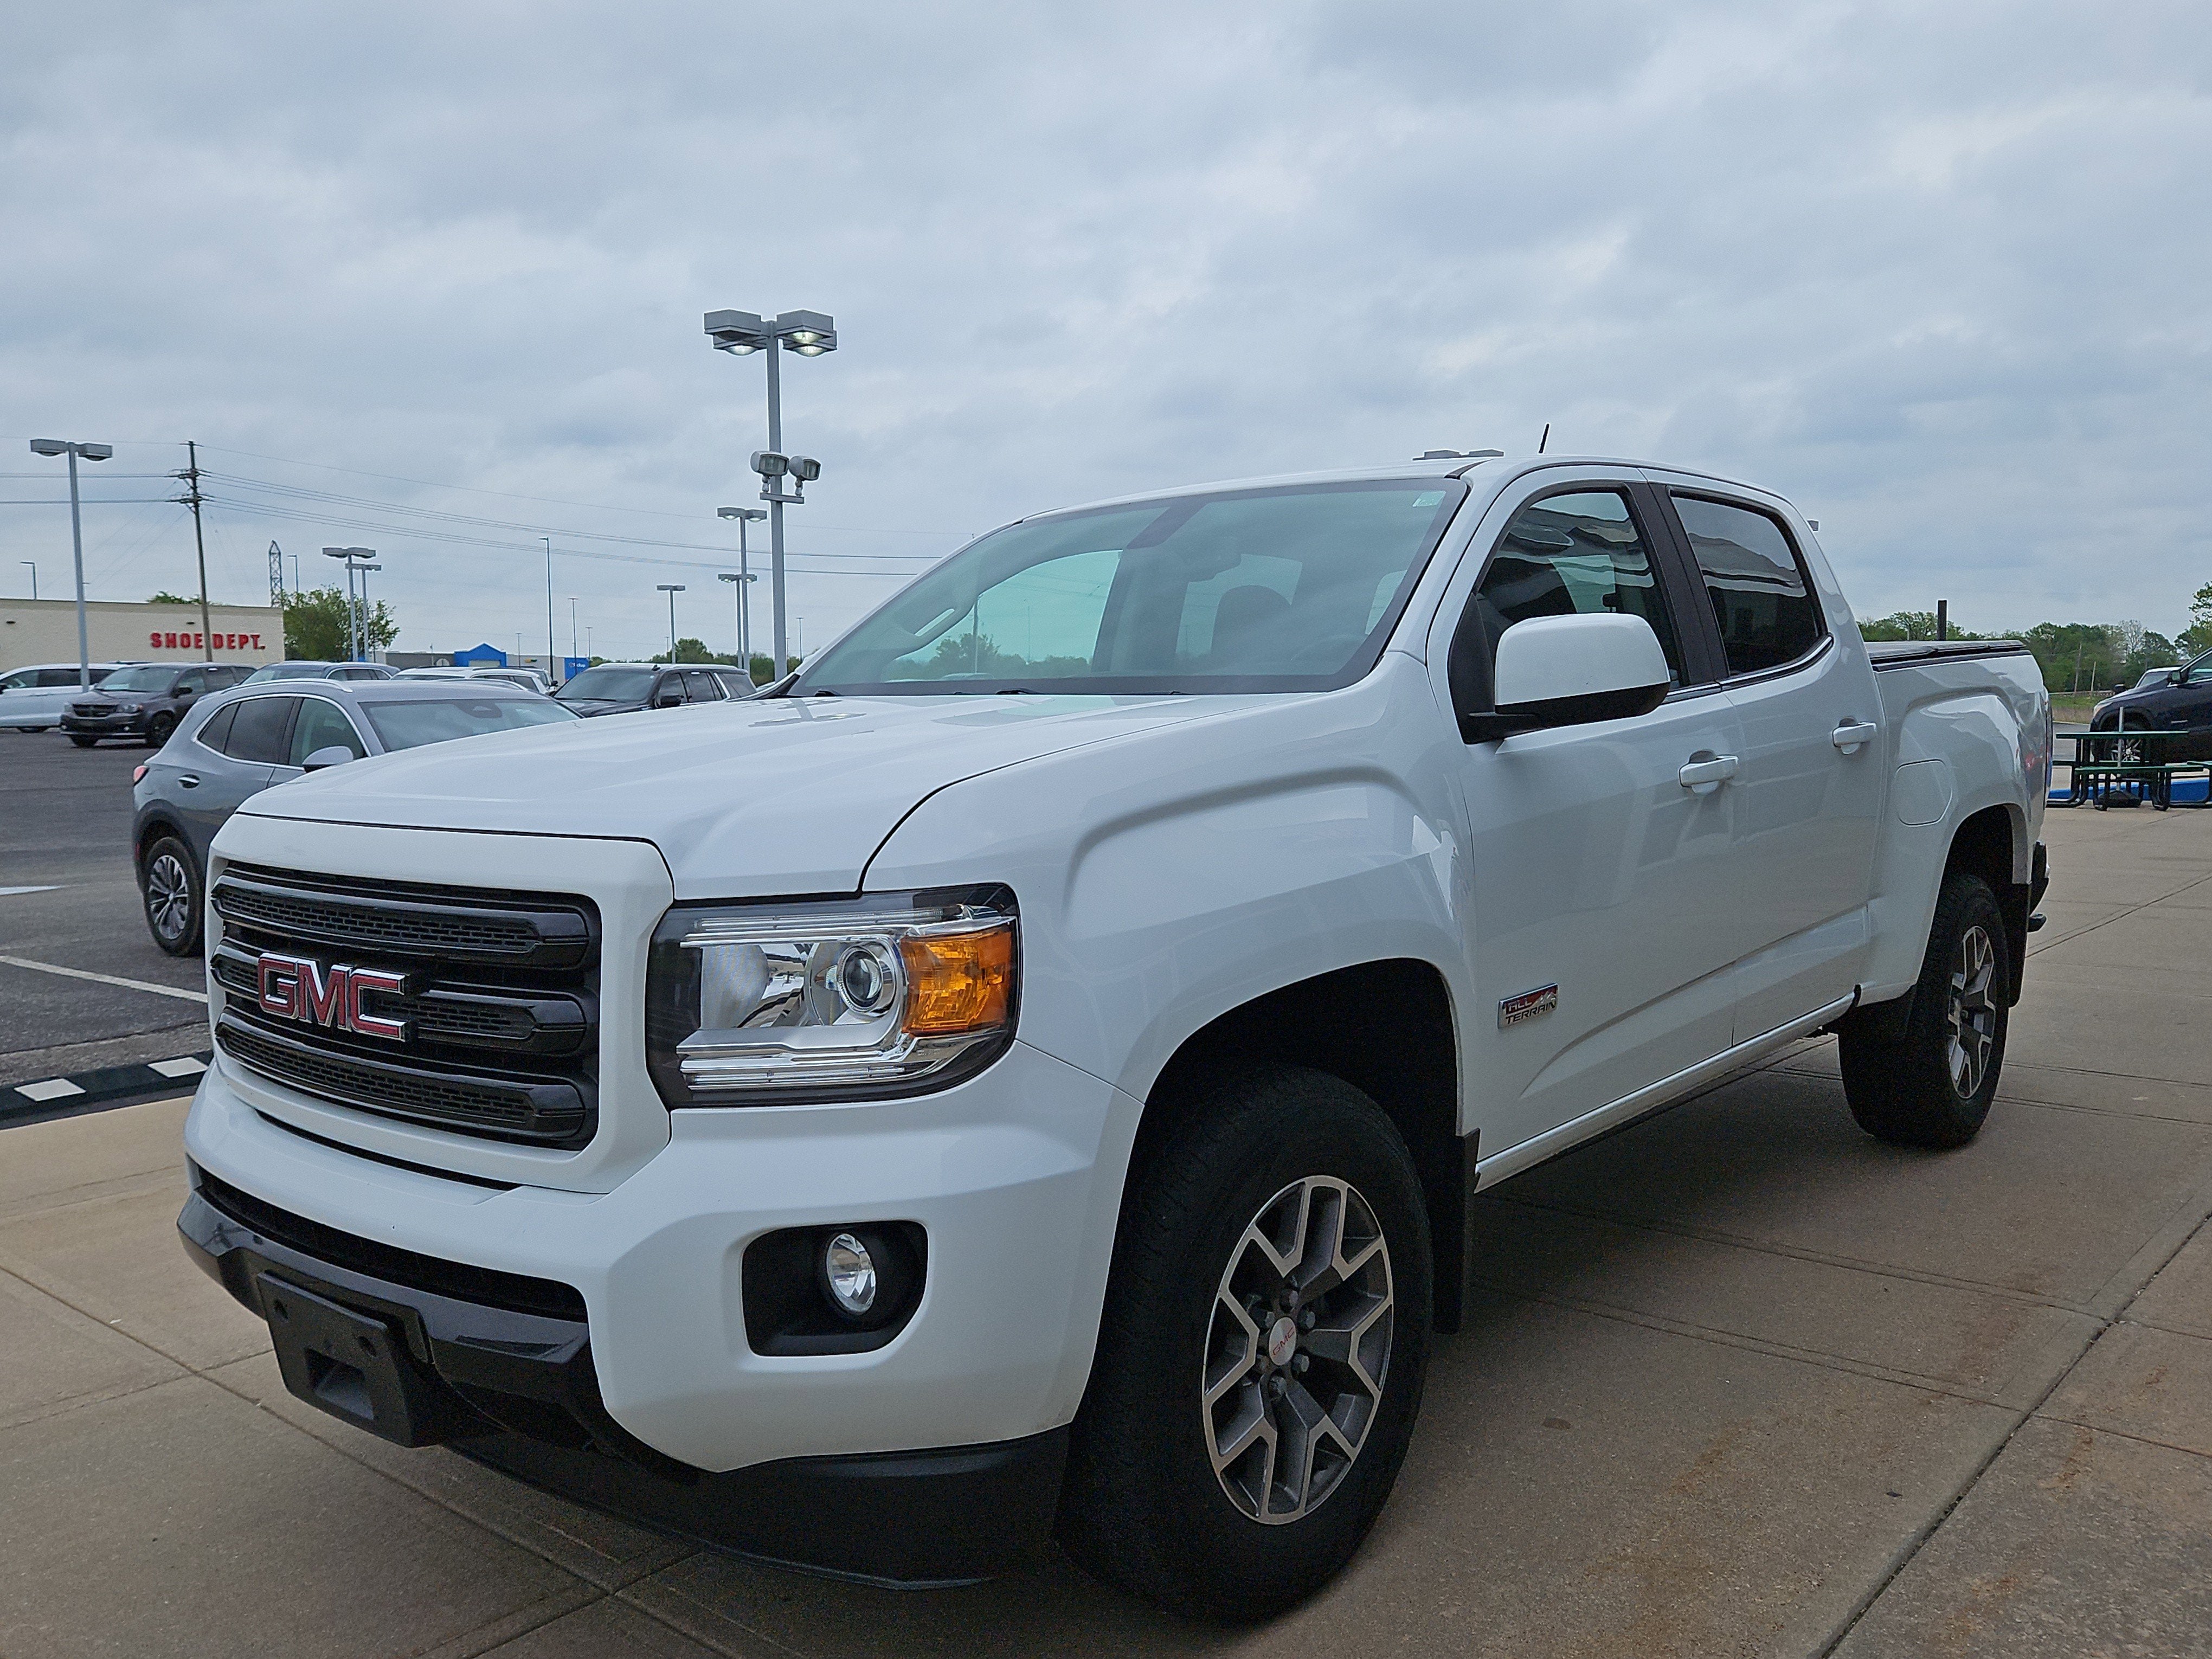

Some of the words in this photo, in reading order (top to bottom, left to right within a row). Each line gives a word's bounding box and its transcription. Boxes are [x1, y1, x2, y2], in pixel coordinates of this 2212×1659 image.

[150, 632, 203, 648] SHOE
[212, 633, 266, 650] DEPT.
[258, 953, 407, 1042] GMC
[1508, 998, 1532, 1012] ALL
[1506, 1002, 1556, 1024] TERRAIN
[1272, 1327, 1295, 1355] GMC
